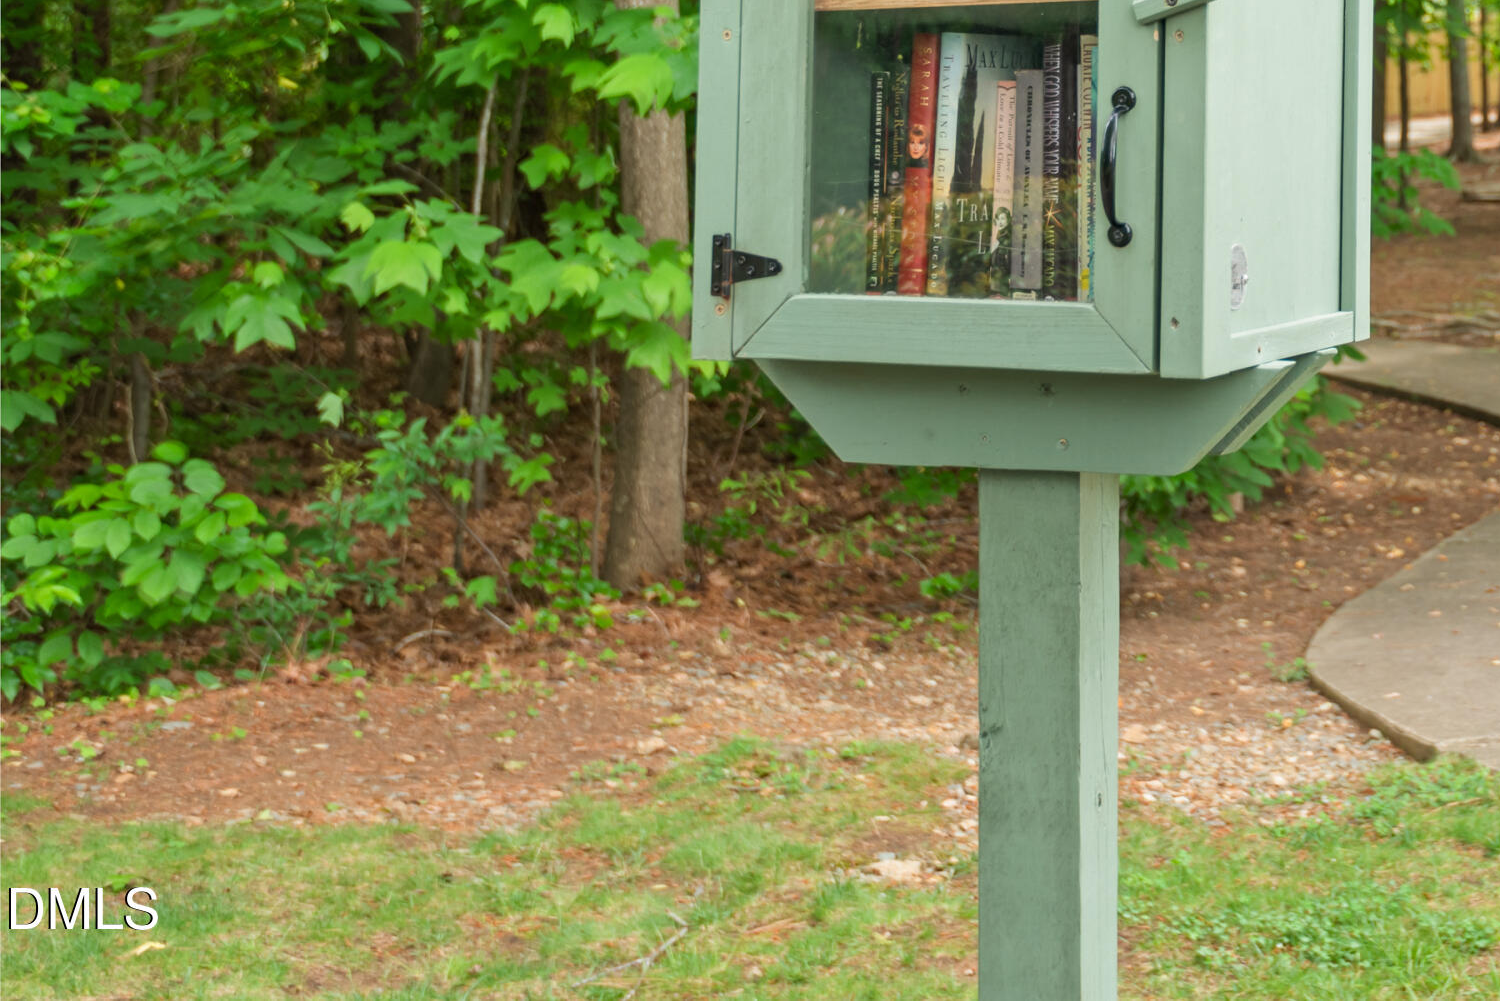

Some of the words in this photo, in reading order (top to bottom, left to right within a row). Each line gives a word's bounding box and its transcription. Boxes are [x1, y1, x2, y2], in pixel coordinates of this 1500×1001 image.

[965, 44, 996, 70] MAX
[1043, 44, 1061, 72] WHEN
[920, 47, 933, 106] SARAH
[1043, 75, 1061, 97] GOD
[875, 91, 883, 126] SEASONING
[1025, 85, 1033, 147] CHRONICLES
[875, 128, 882, 136] OF
[1043, 100, 1060, 147] WHISPERS
[936, 147, 949, 191] LIGHT
[1025, 149, 1031, 162] OF
[1043, 149, 1060, 175] YOUR
[934, 200, 944, 228] MAX
[930, 235, 943, 288] LUCADO
